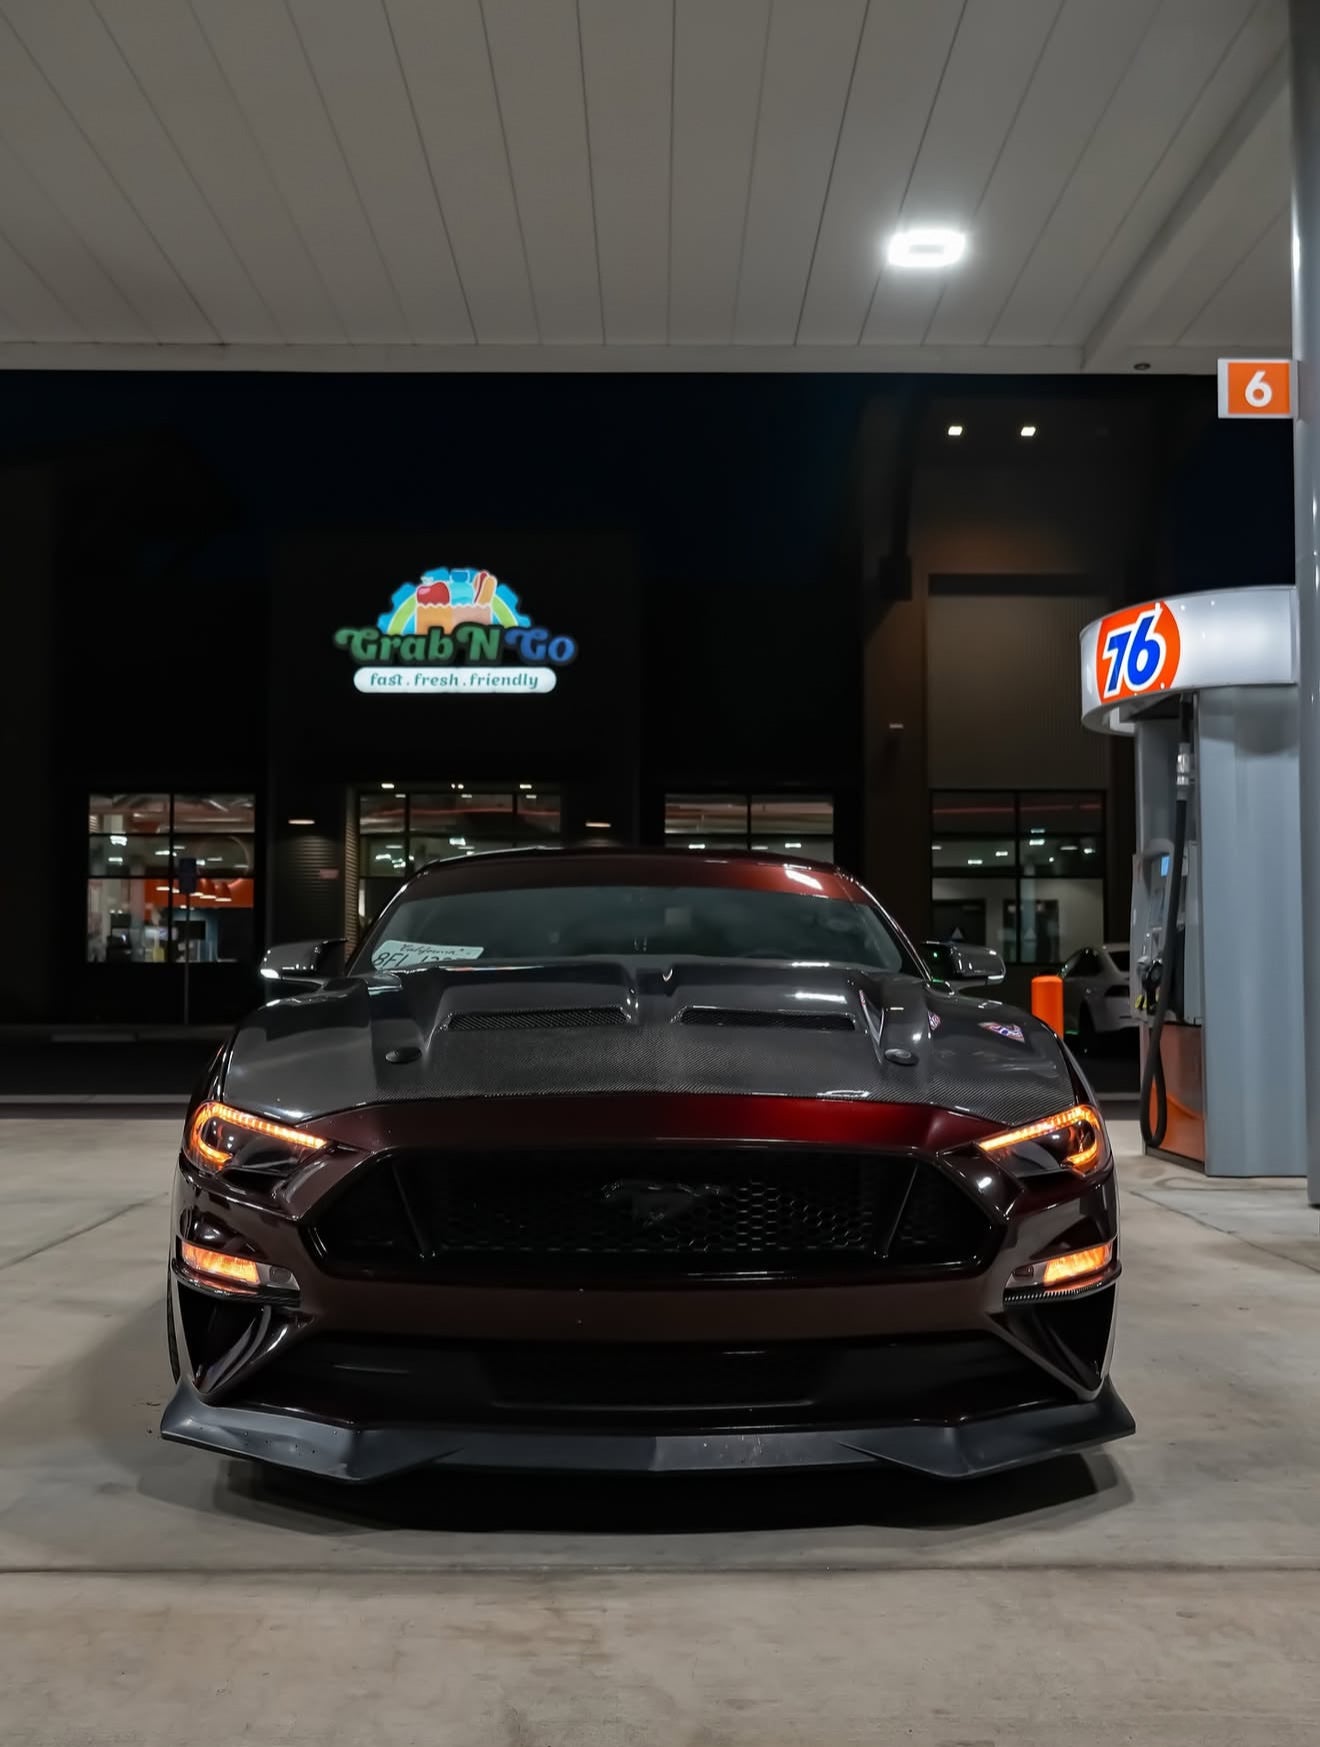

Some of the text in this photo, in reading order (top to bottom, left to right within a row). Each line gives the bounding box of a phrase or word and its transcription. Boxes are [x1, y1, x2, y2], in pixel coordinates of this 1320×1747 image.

[1245, 369, 1273, 408] 6
[334, 625, 576, 662] Grab N Go
[1103, 608, 1166, 698] 76
[370, 672, 539, 690] fast fresh friendly
